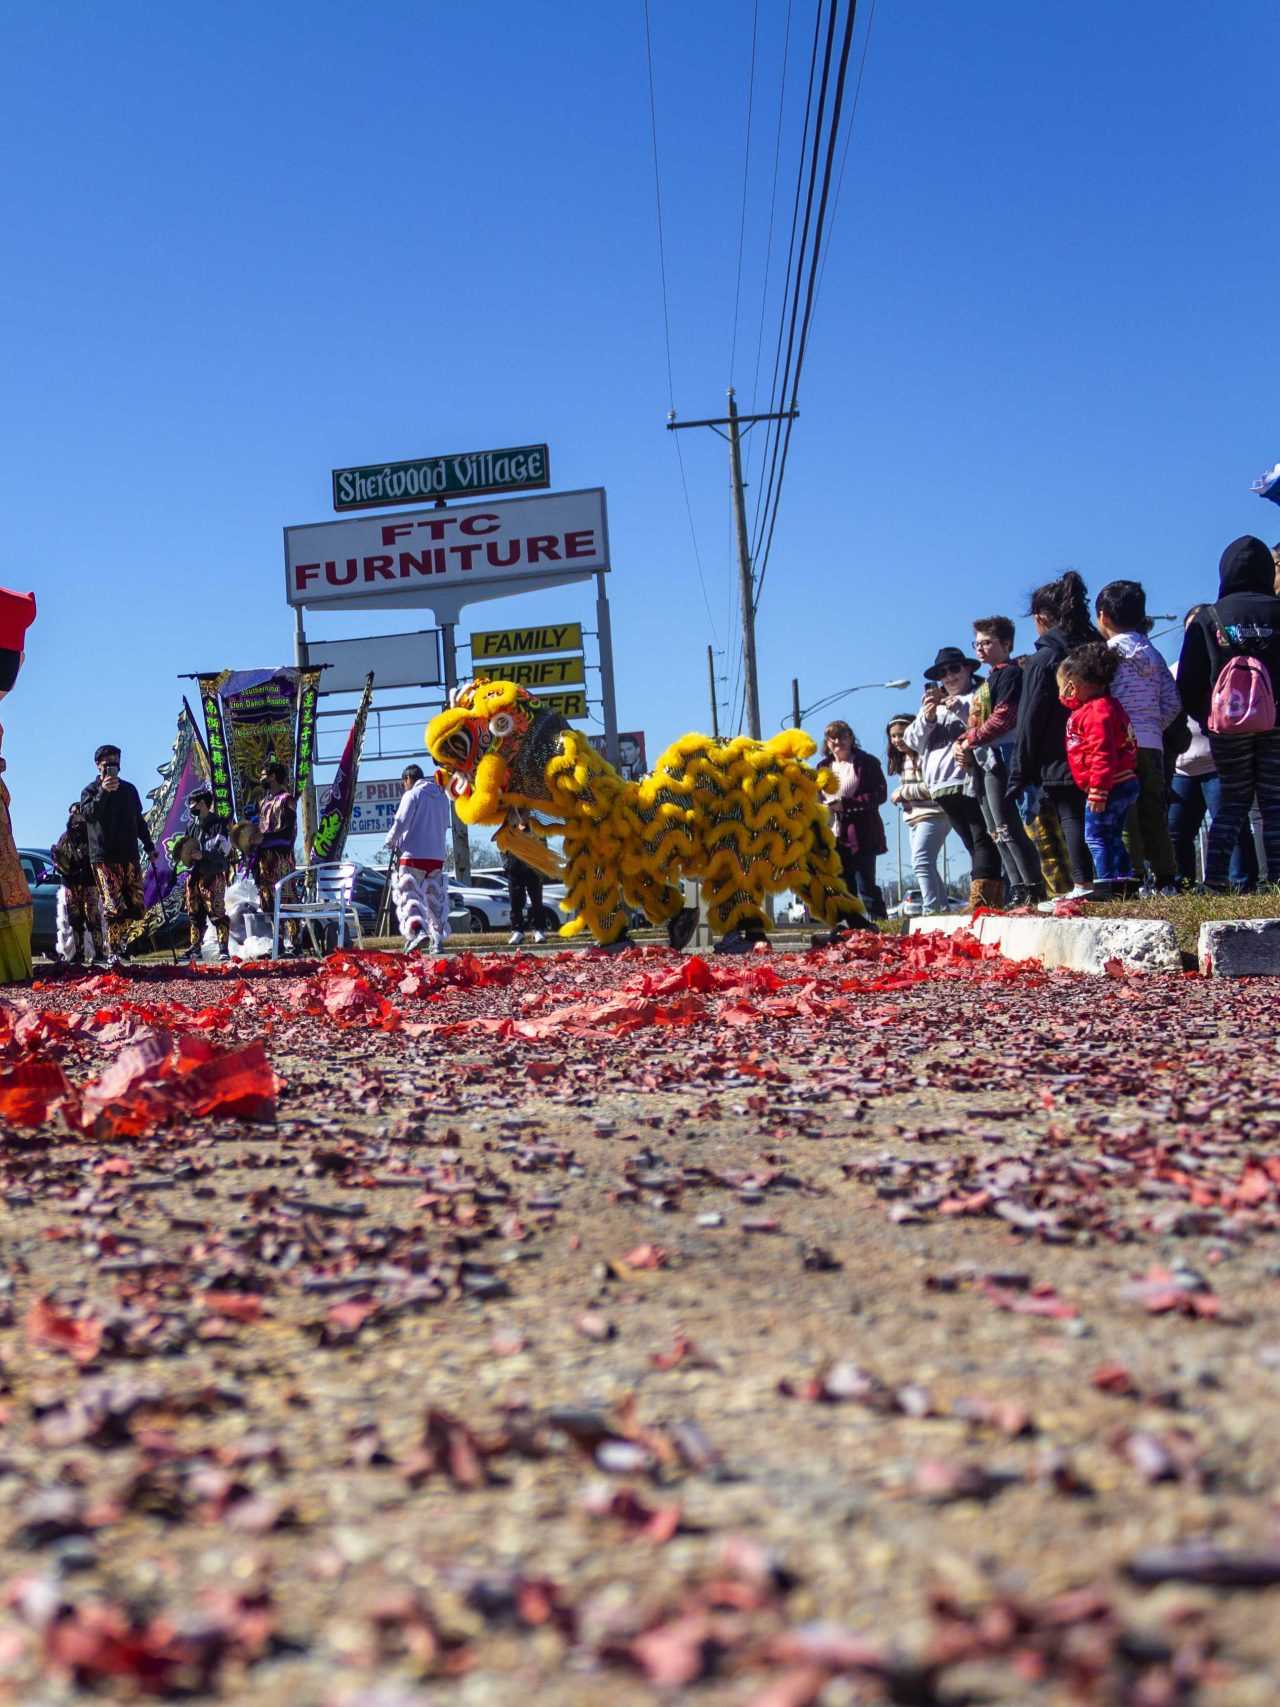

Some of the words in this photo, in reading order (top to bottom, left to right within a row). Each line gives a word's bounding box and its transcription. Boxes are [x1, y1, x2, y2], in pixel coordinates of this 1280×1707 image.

[339, 460, 447, 502] Sherwood
[381, 513, 502, 547] FTC
[294, 529, 597, 591] FURNITURE
[483, 628, 569, 654] FAMILY
[484, 661, 573, 684] THRIFT
